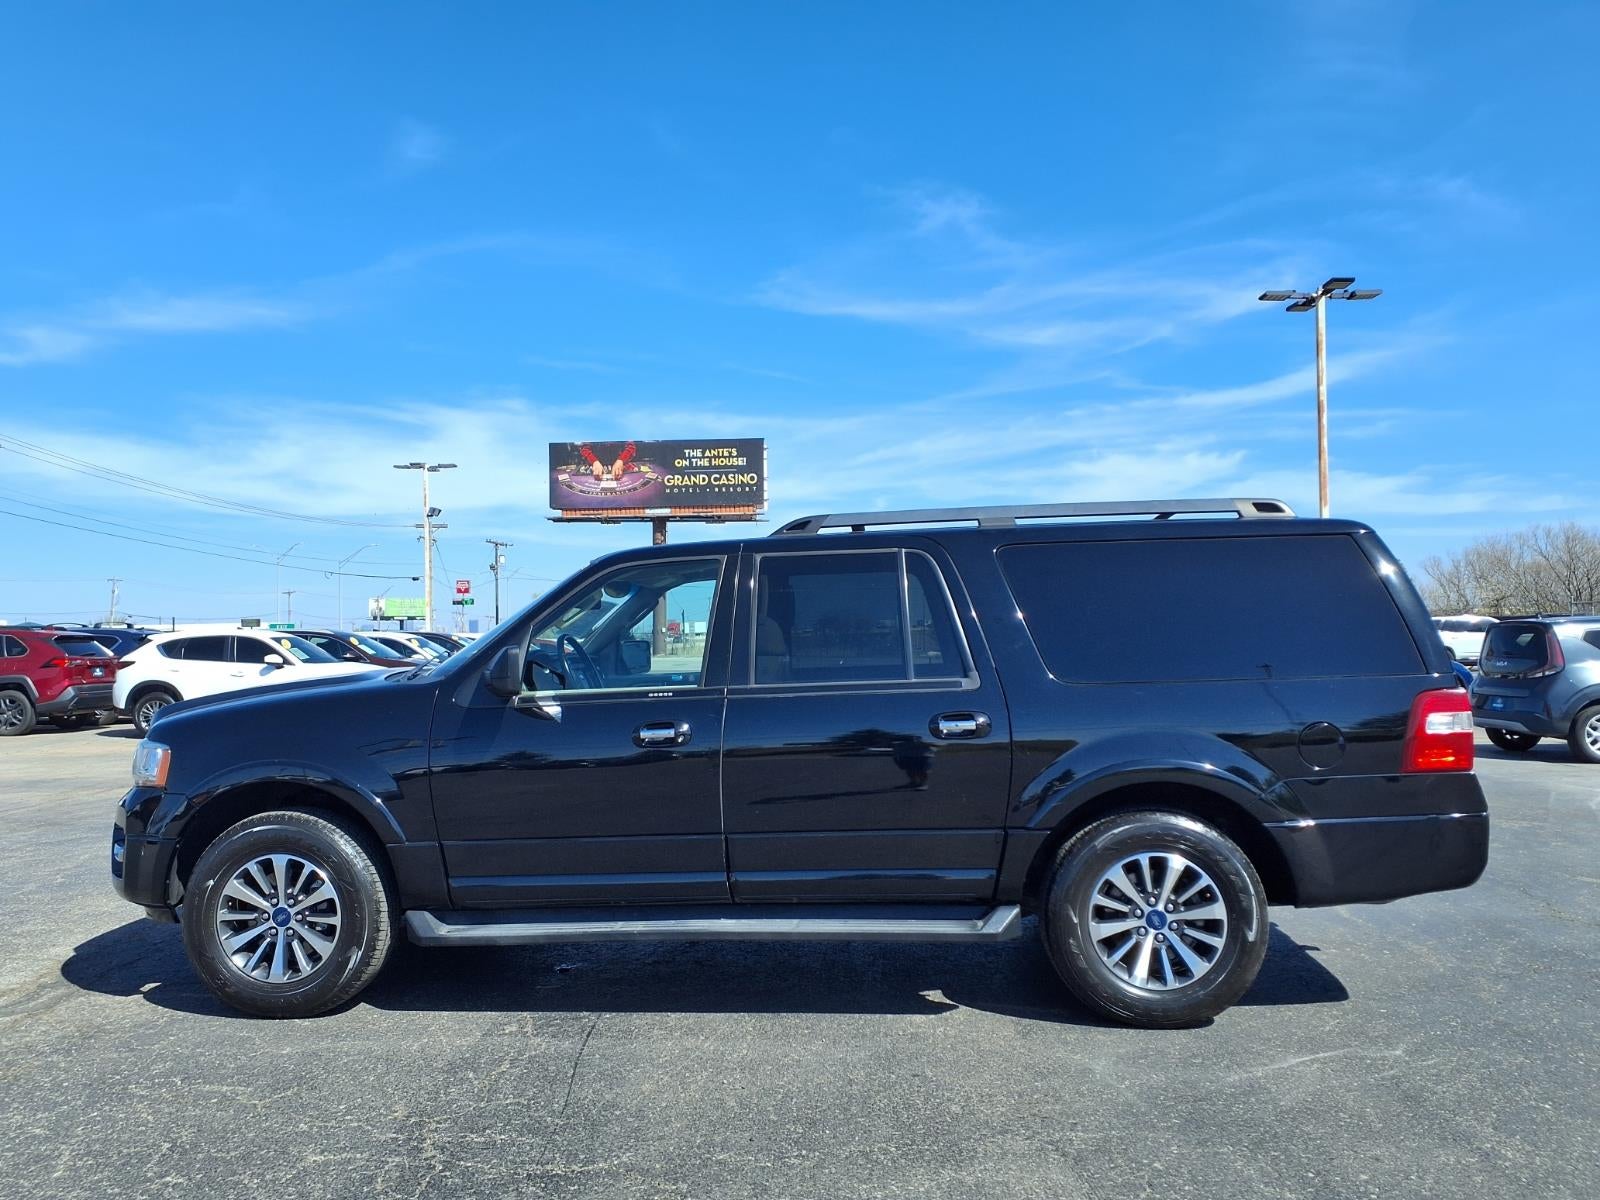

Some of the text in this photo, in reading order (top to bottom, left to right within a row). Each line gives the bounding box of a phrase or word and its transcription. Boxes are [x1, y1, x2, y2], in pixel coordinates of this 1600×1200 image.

[684, 448, 737, 457] THE ANTE'S
[675, 457, 746, 467] ON THE HOUSE!
[664, 473, 757, 486] GRAND CASINO
